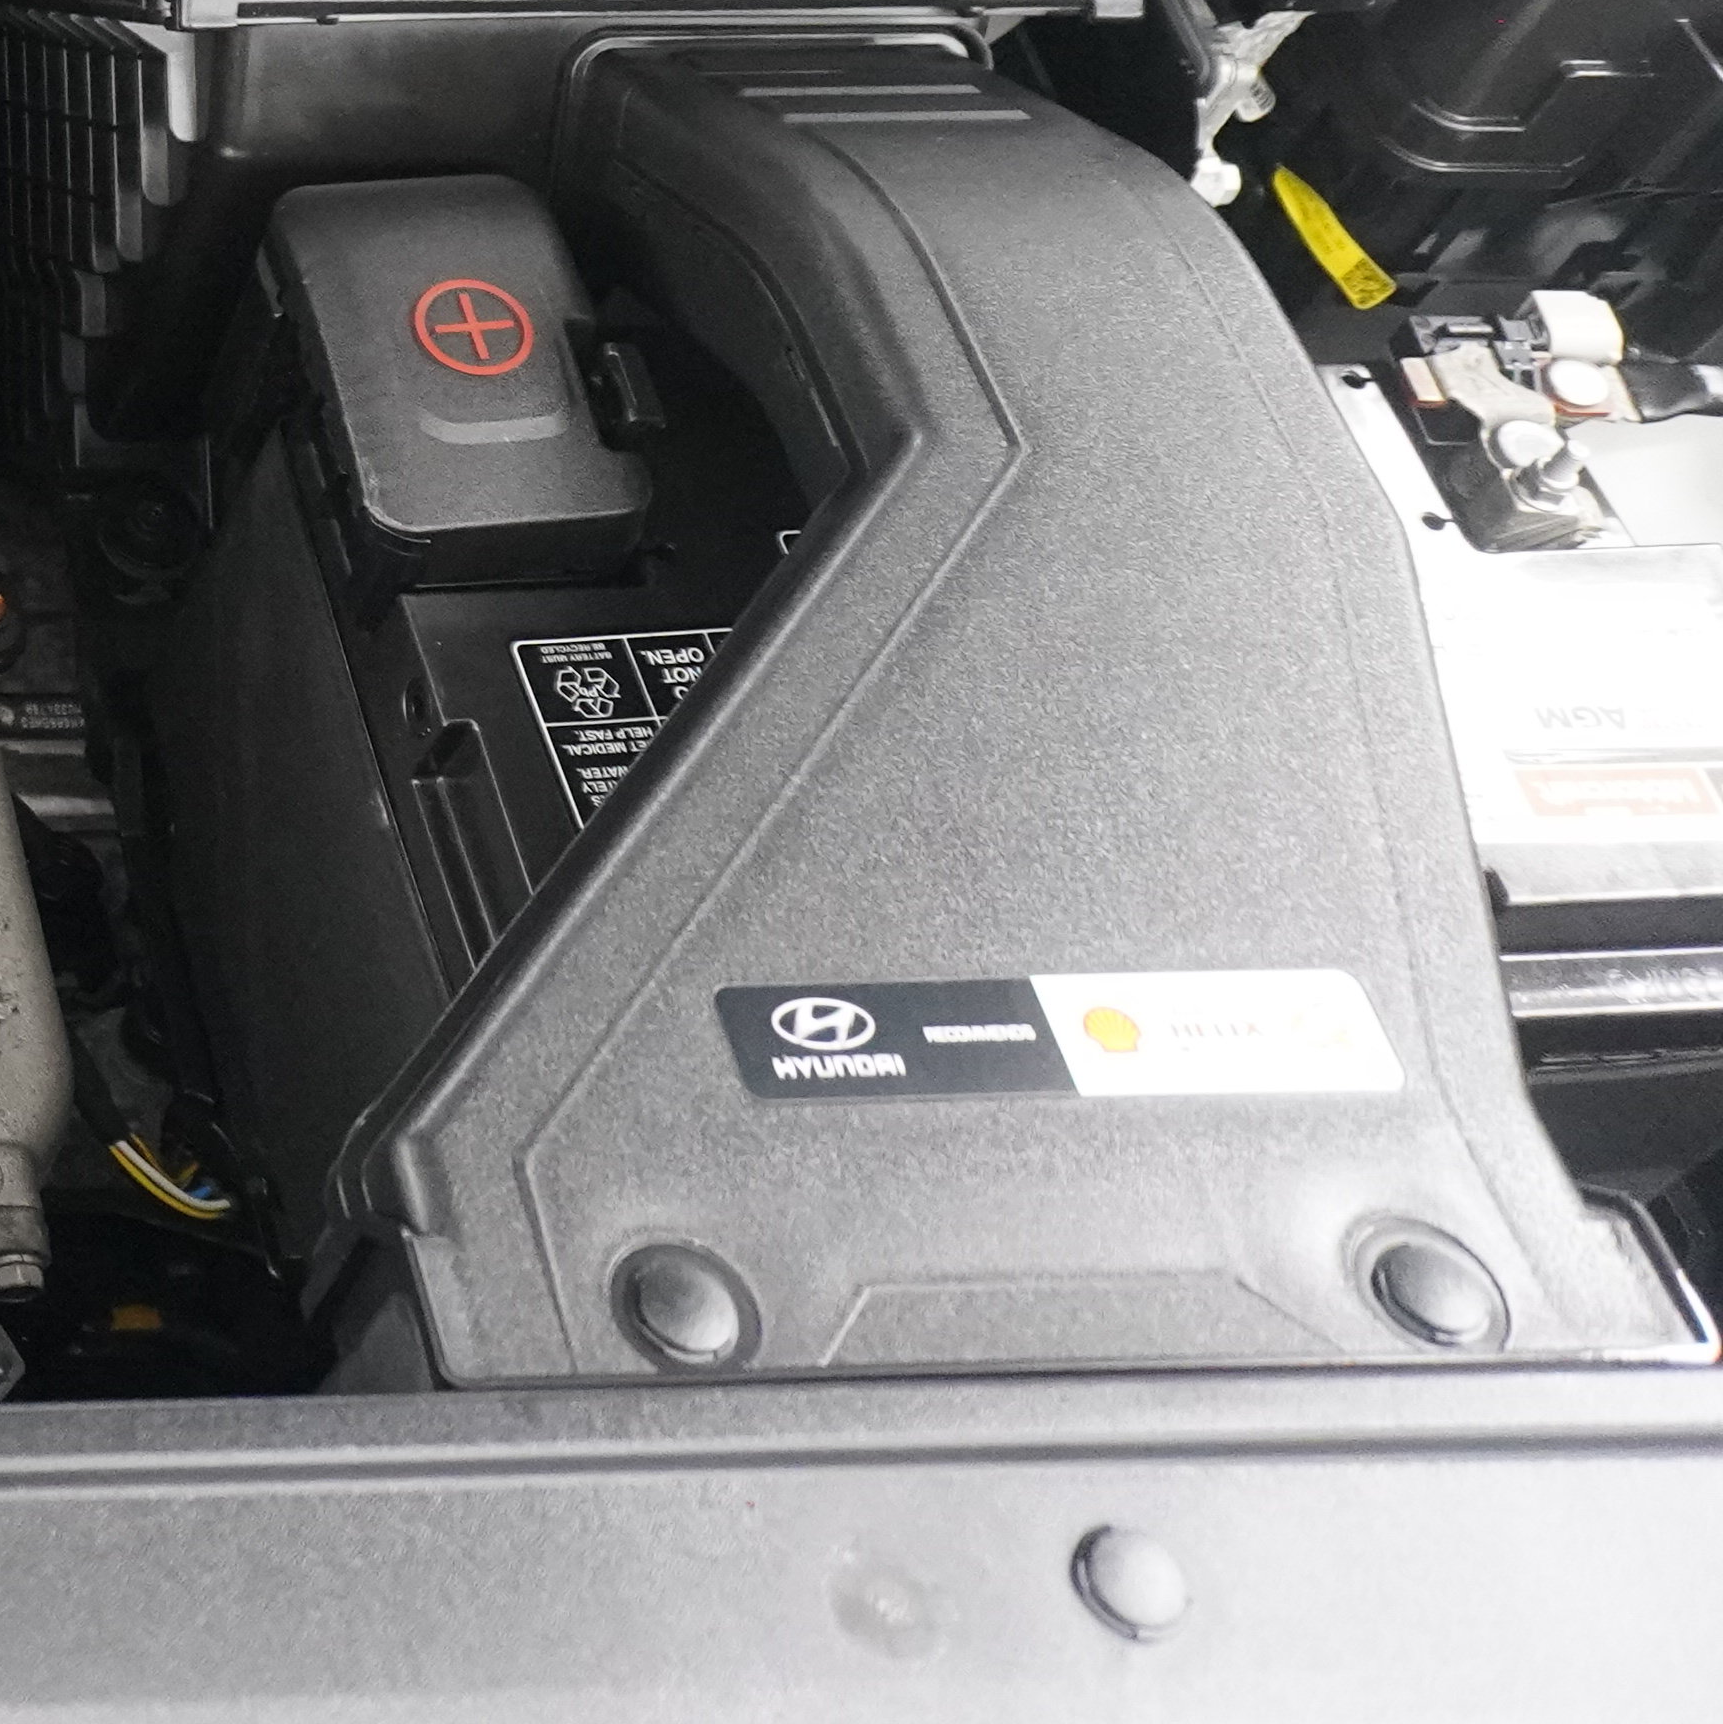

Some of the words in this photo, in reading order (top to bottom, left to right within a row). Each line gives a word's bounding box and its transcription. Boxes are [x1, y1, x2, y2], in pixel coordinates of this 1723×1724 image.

[540, 643, 591, 654] RECYCLED
[541, 654, 568, 664] MUST
[570, 651, 613, 662] BATTERY
[640, 647, 705, 665] OPEN.
[662, 667, 703, 684] NOT
[1534, 706, 1627, 730] AGM
[574, 729, 612, 742] FAST.
[615, 726, 654, 739] HELP
[562, 743, 626, 756] MEDICAL
[627, 741, 650, 753] ET
[772, 1053, 907, 1080] HYUNDAI
